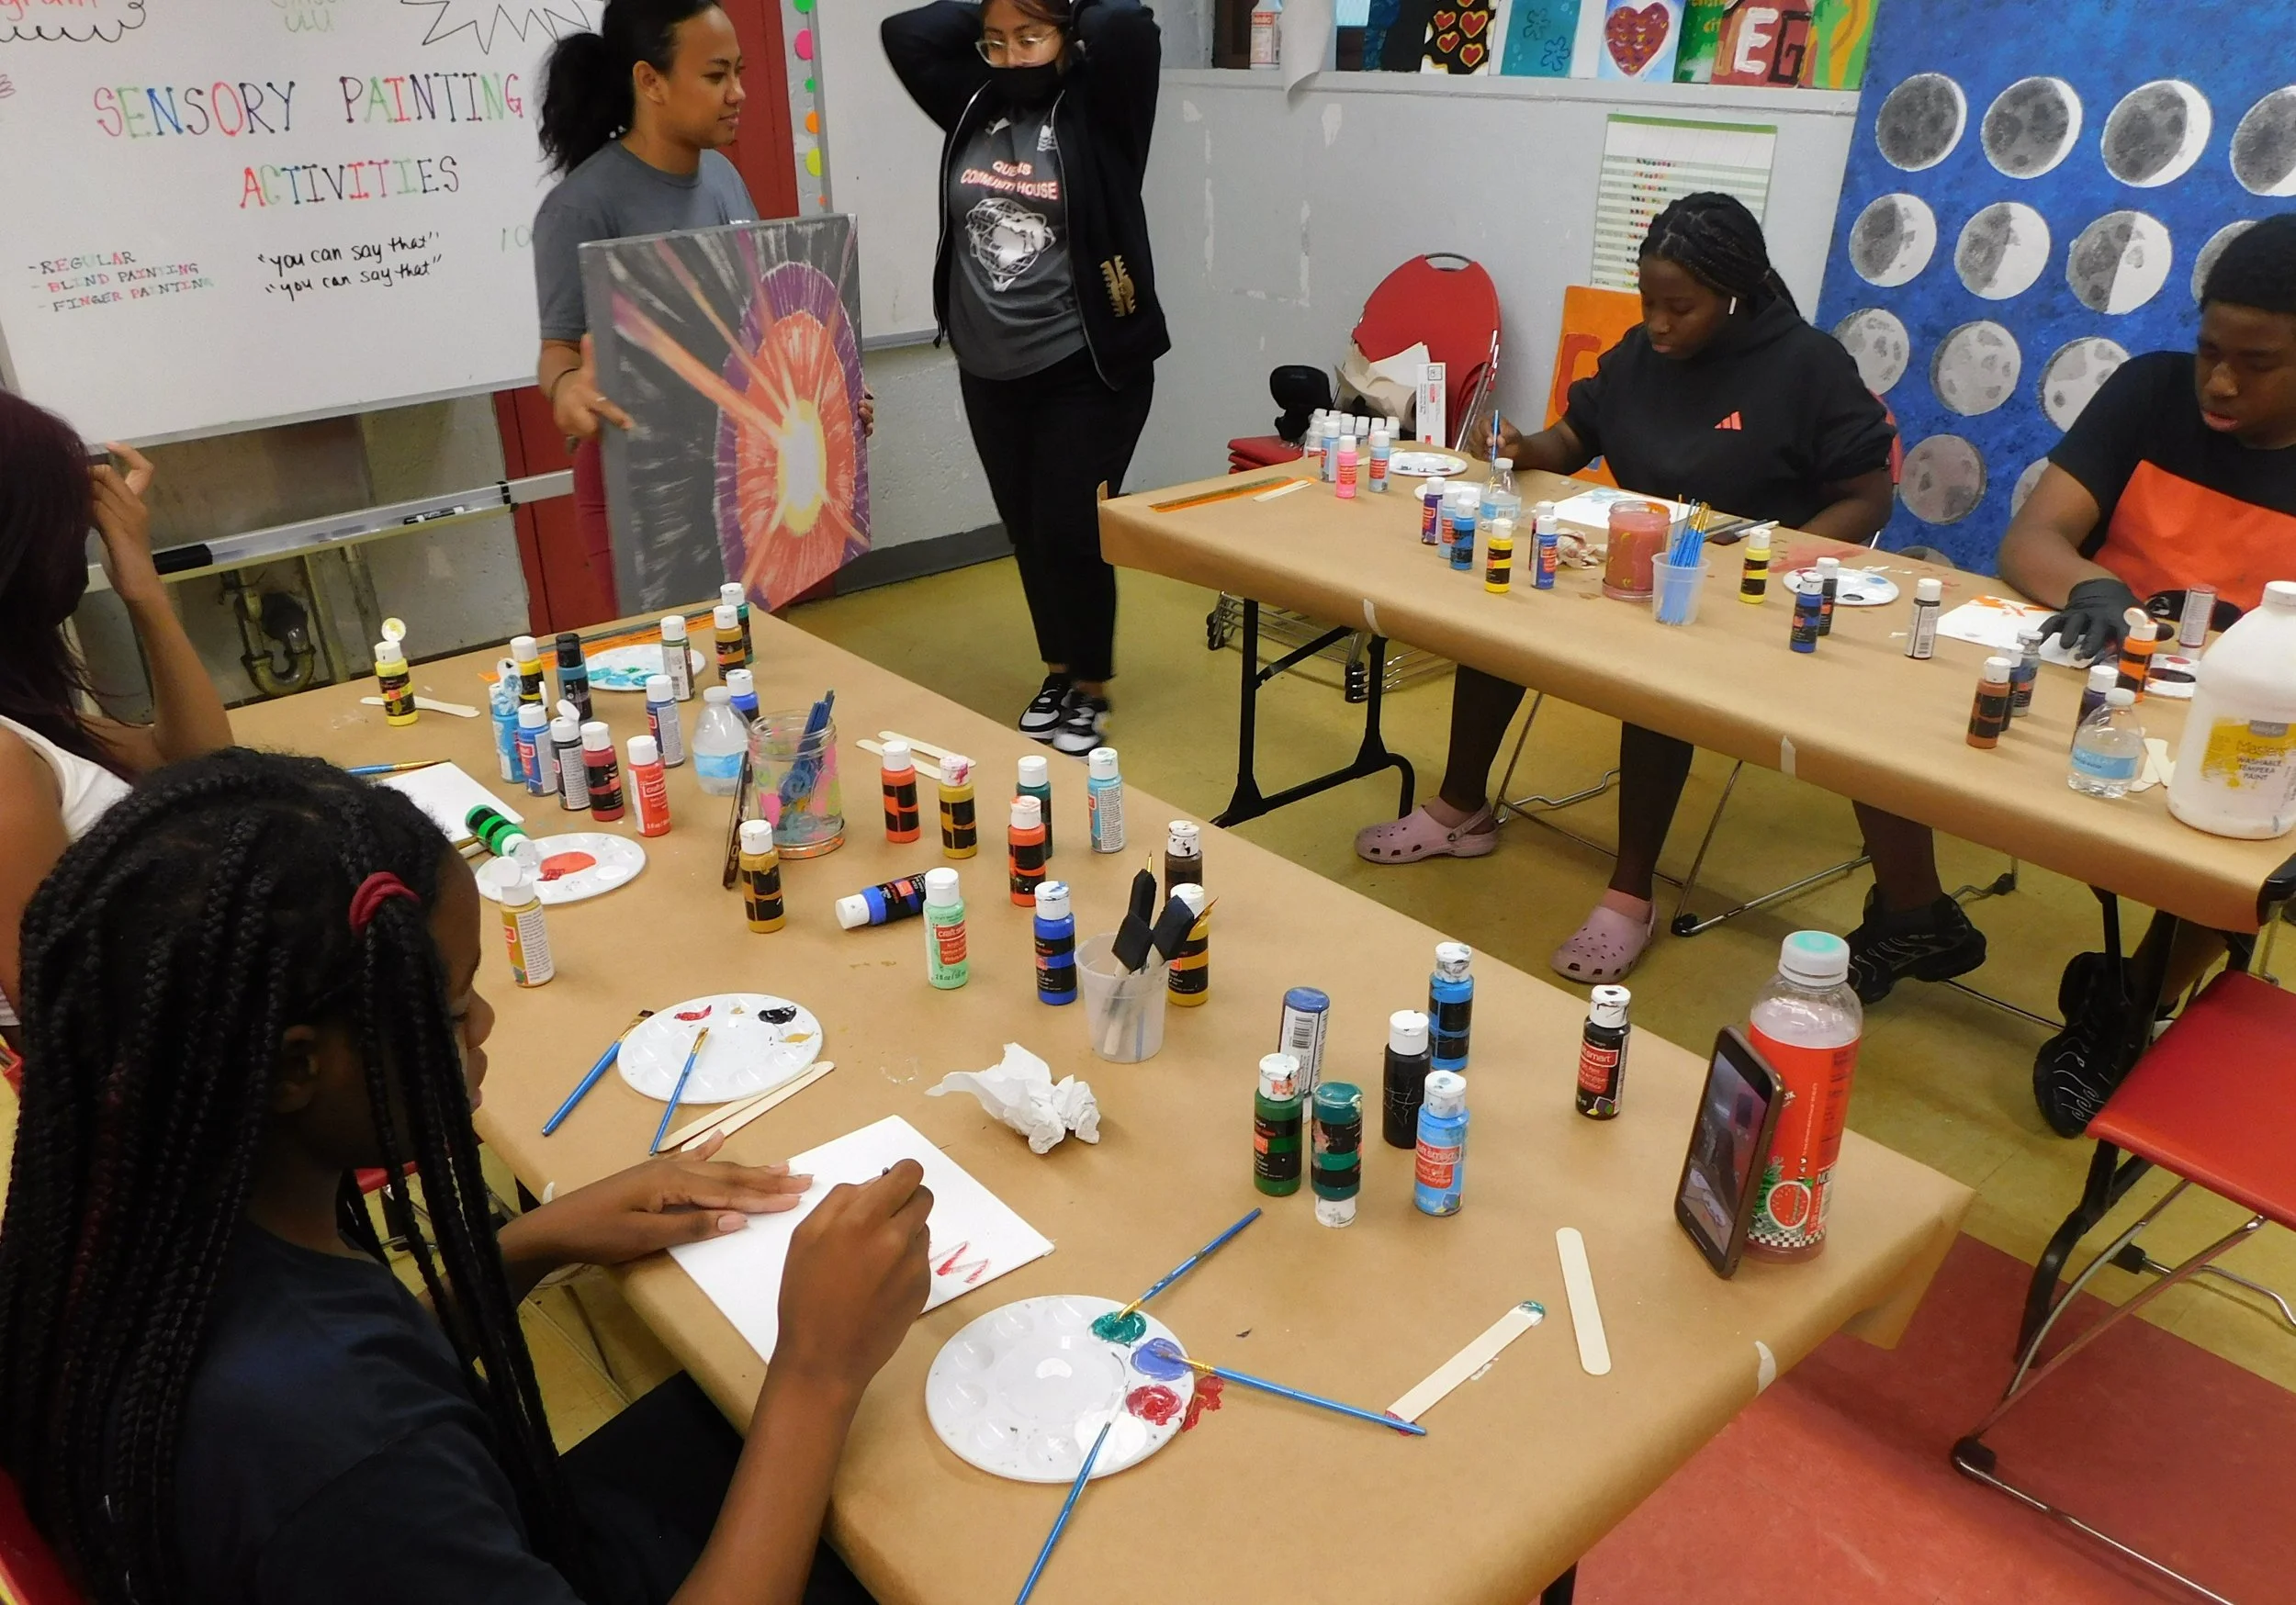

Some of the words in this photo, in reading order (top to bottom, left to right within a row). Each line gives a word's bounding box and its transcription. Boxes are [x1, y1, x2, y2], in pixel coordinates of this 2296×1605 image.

[94, 81, 296, 138] SENSORY
[338, 72, 523, 123] PAINTING
[240, 155, 459, 209] ACTIVITIES
[1017, 180, 1058, 200] HOUSE
[310, 246, 343, 264] can
[351, 242, 382, 264] say
[117, 263, 199, 284] PAINTING
[322, 275, 353, 289] can
[360, 267, 393, 287] say
[2243, 772, 2268, 780] PAINT
